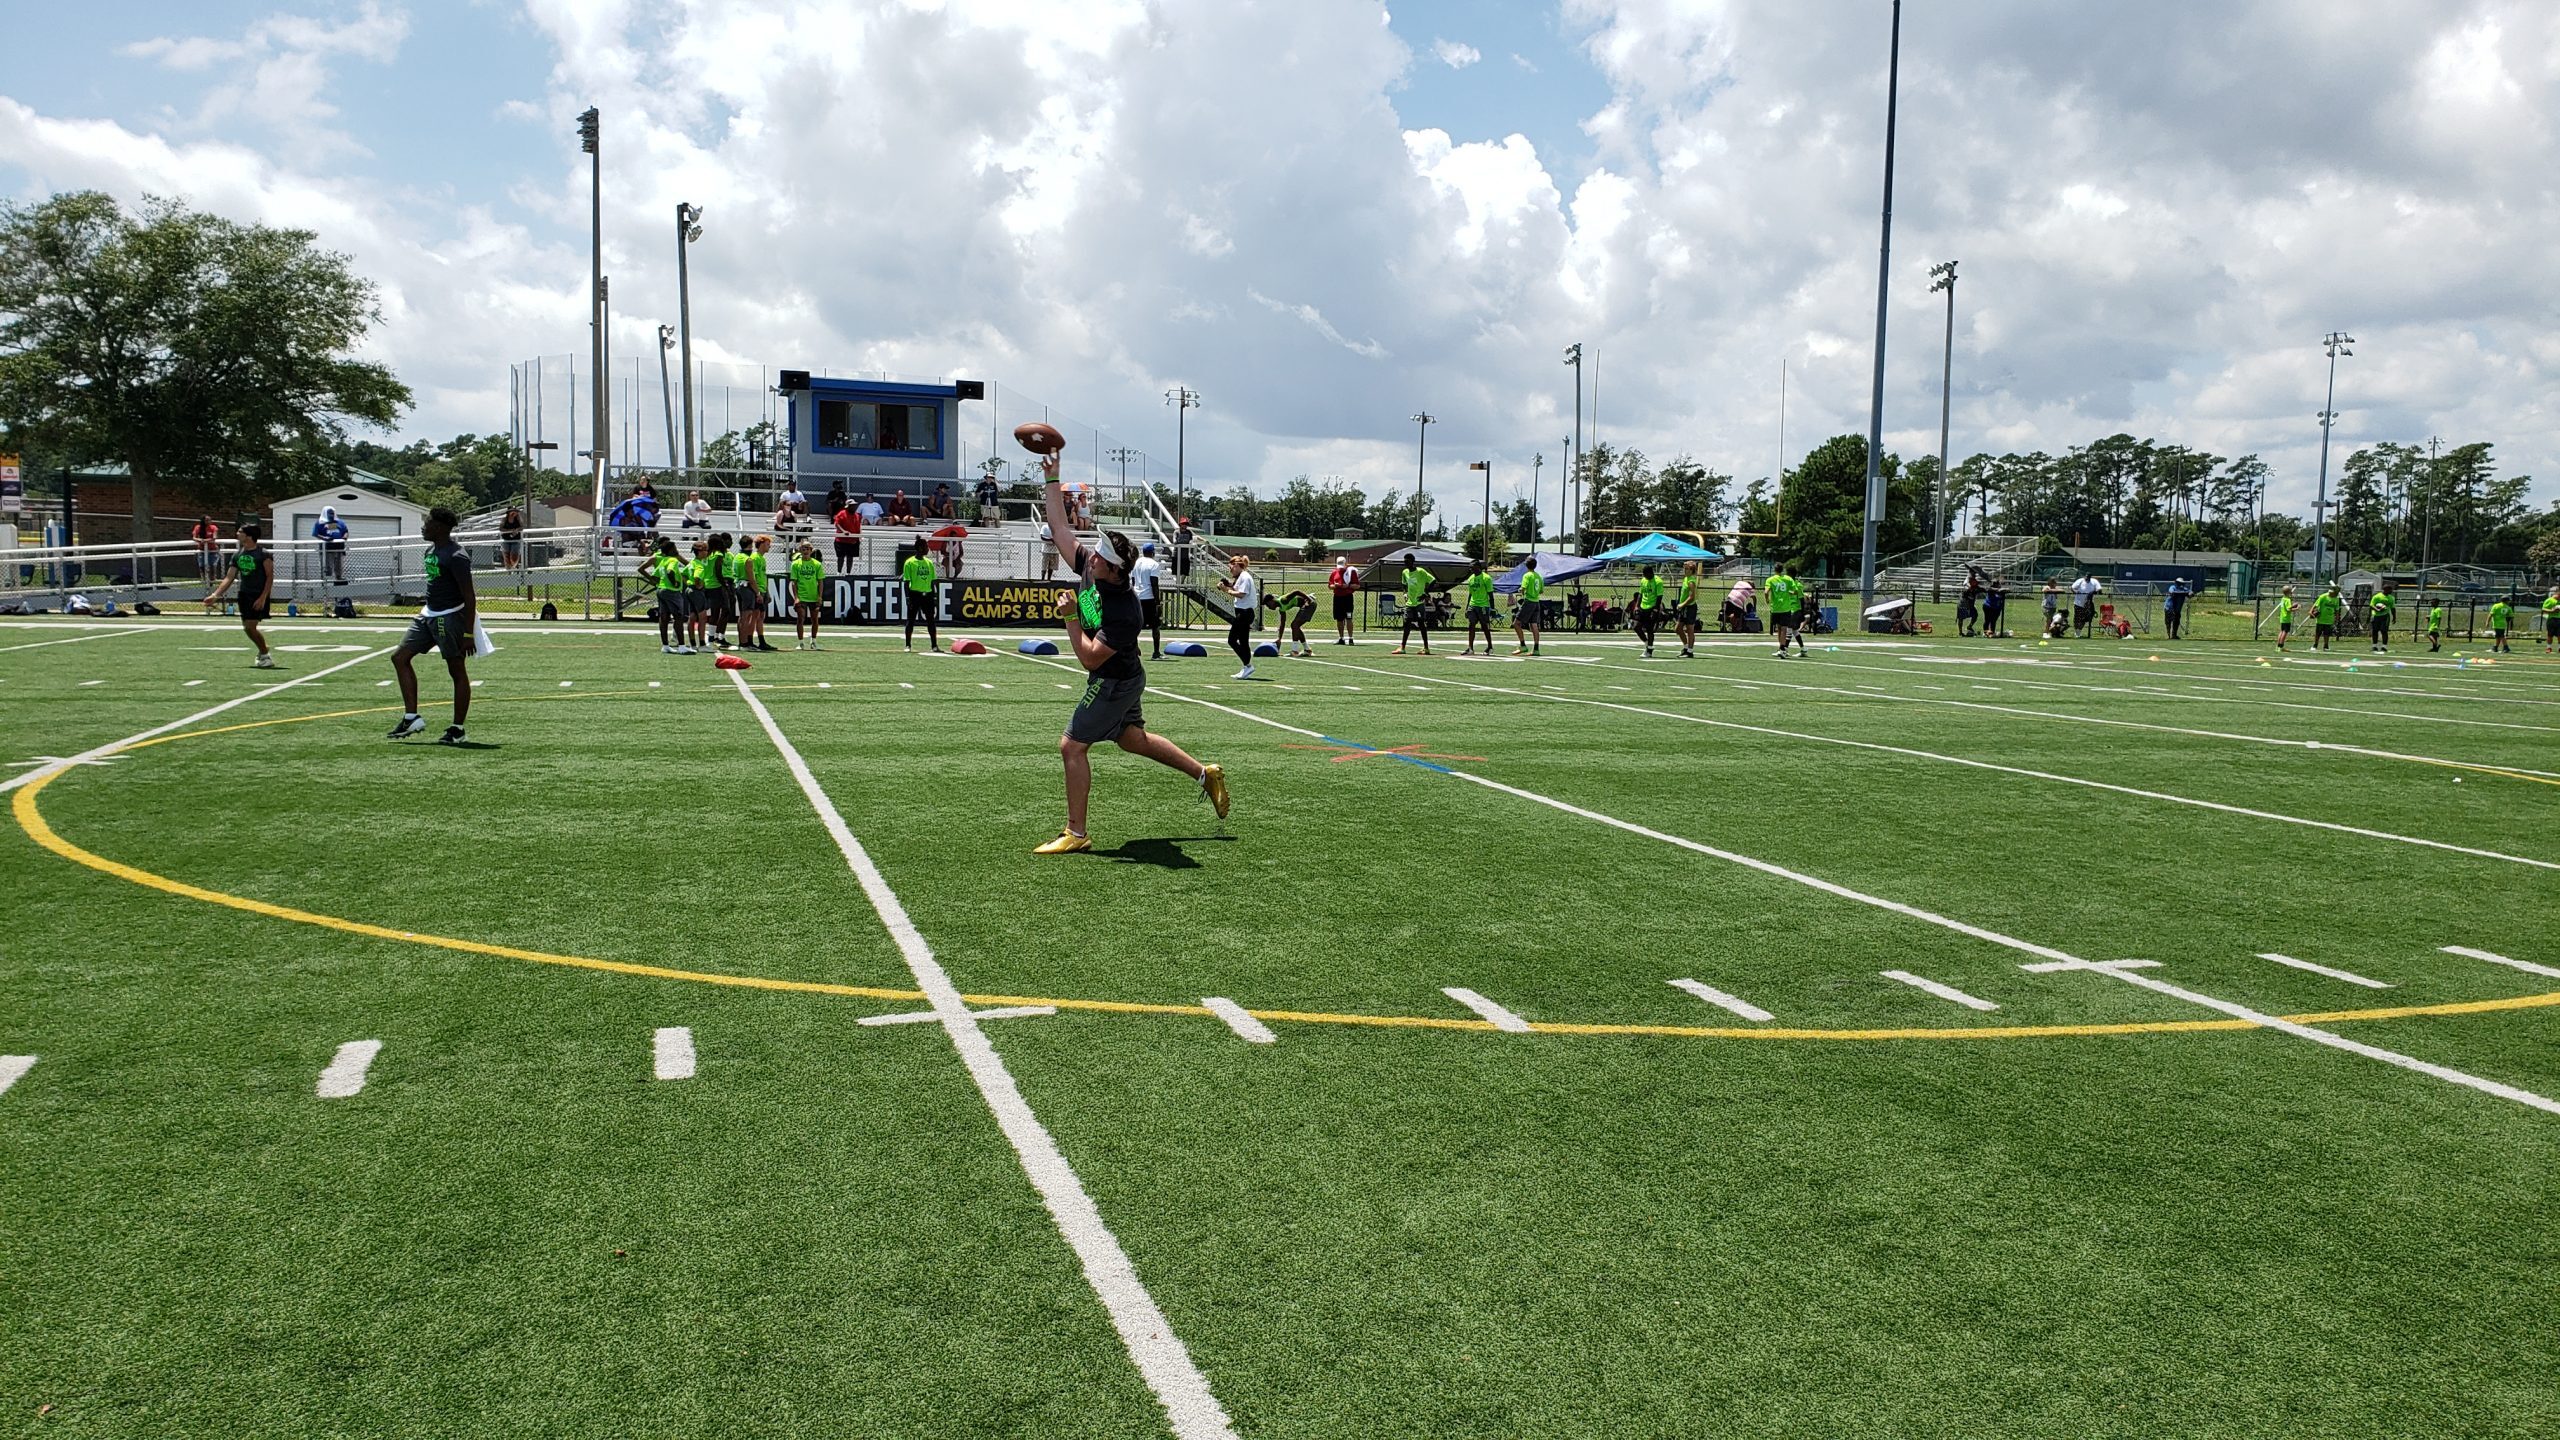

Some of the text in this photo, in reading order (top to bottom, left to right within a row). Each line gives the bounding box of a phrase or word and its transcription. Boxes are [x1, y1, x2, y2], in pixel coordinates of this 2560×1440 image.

[962, 603, 1022, 619] CAMPS
[1025, 604, 1039, 619] &
[1081, 683, 1101, 709] ELITE
